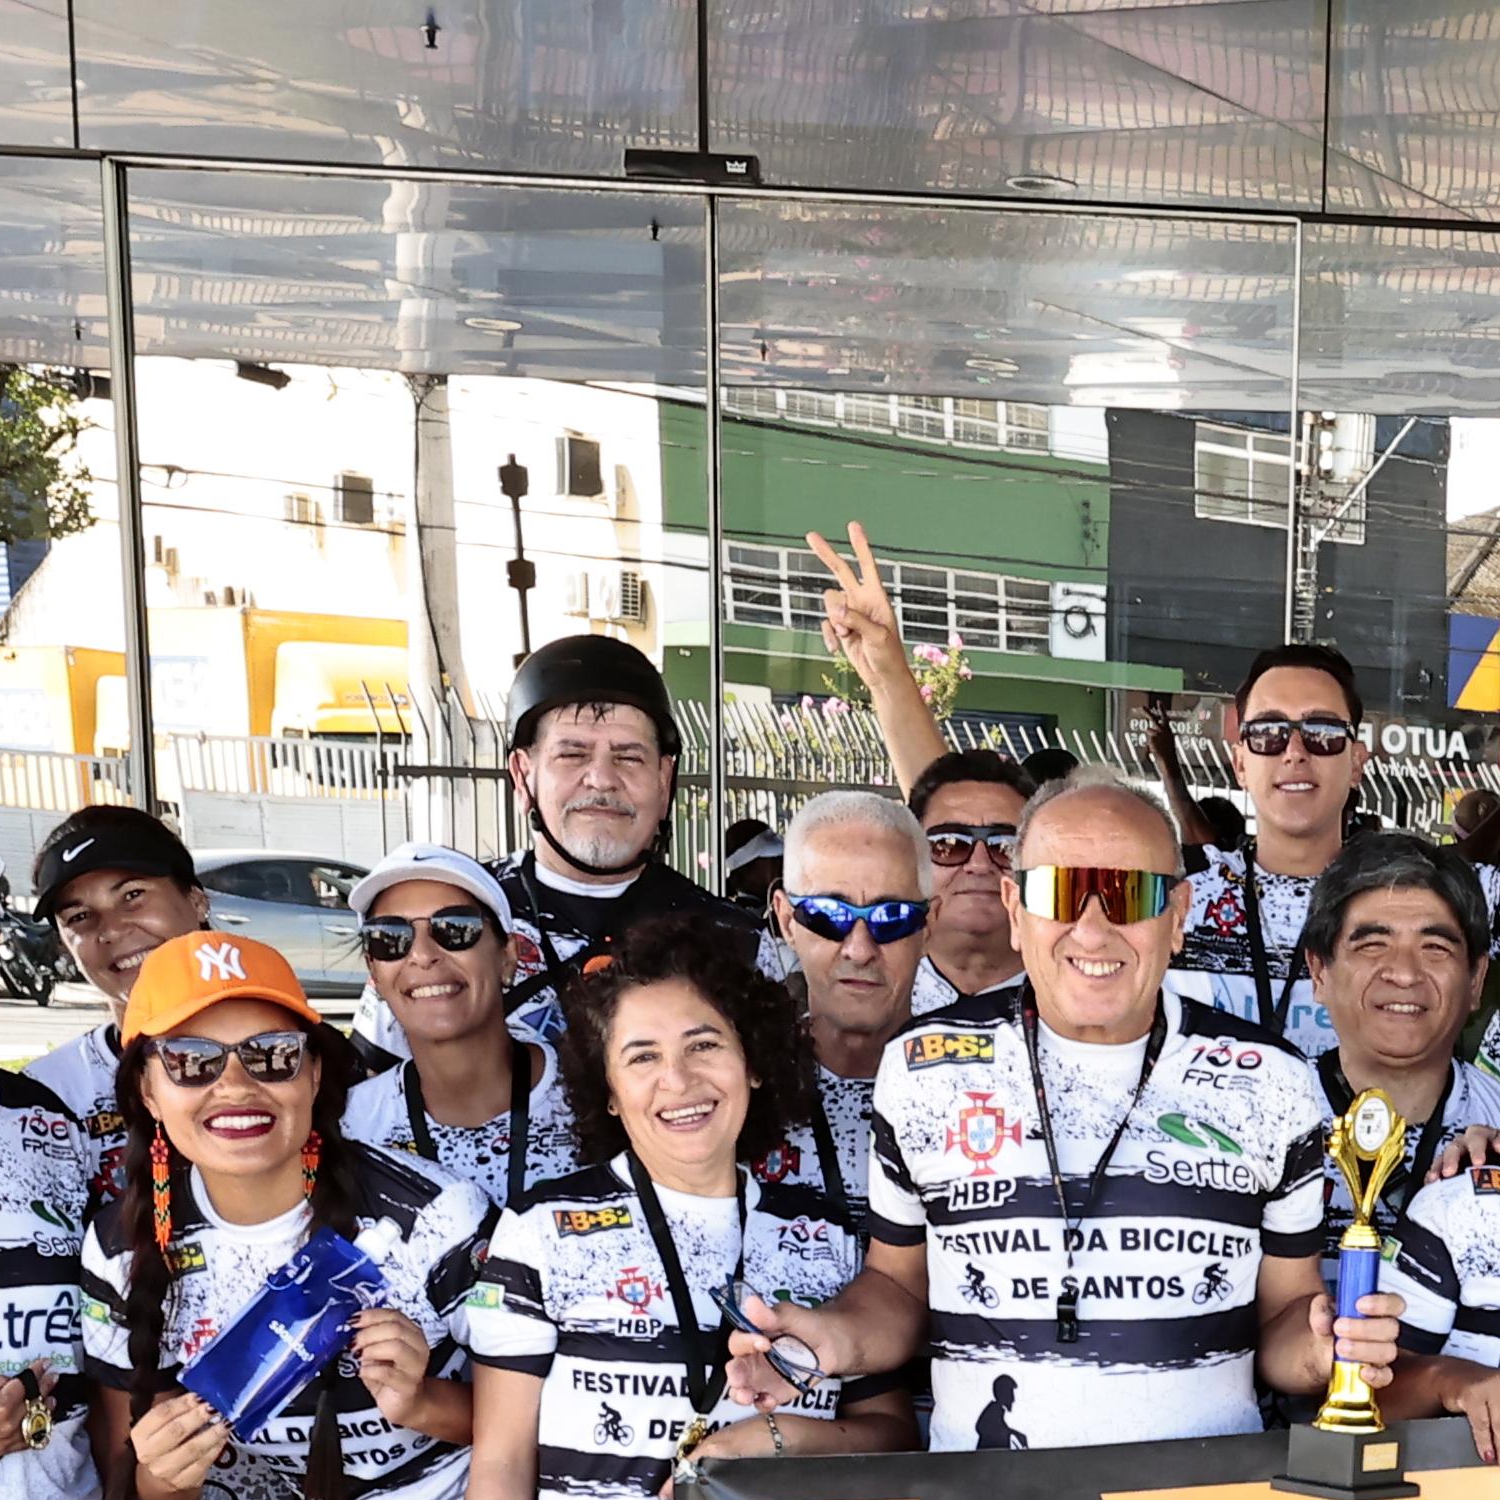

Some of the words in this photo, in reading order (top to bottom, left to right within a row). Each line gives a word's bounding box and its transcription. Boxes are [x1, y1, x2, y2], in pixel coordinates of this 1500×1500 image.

[952, 1180, 1012, 1207] HBP
[1012, 1277, 1050, 1300] DE
[617, 1318, 662, 1338] HBP
